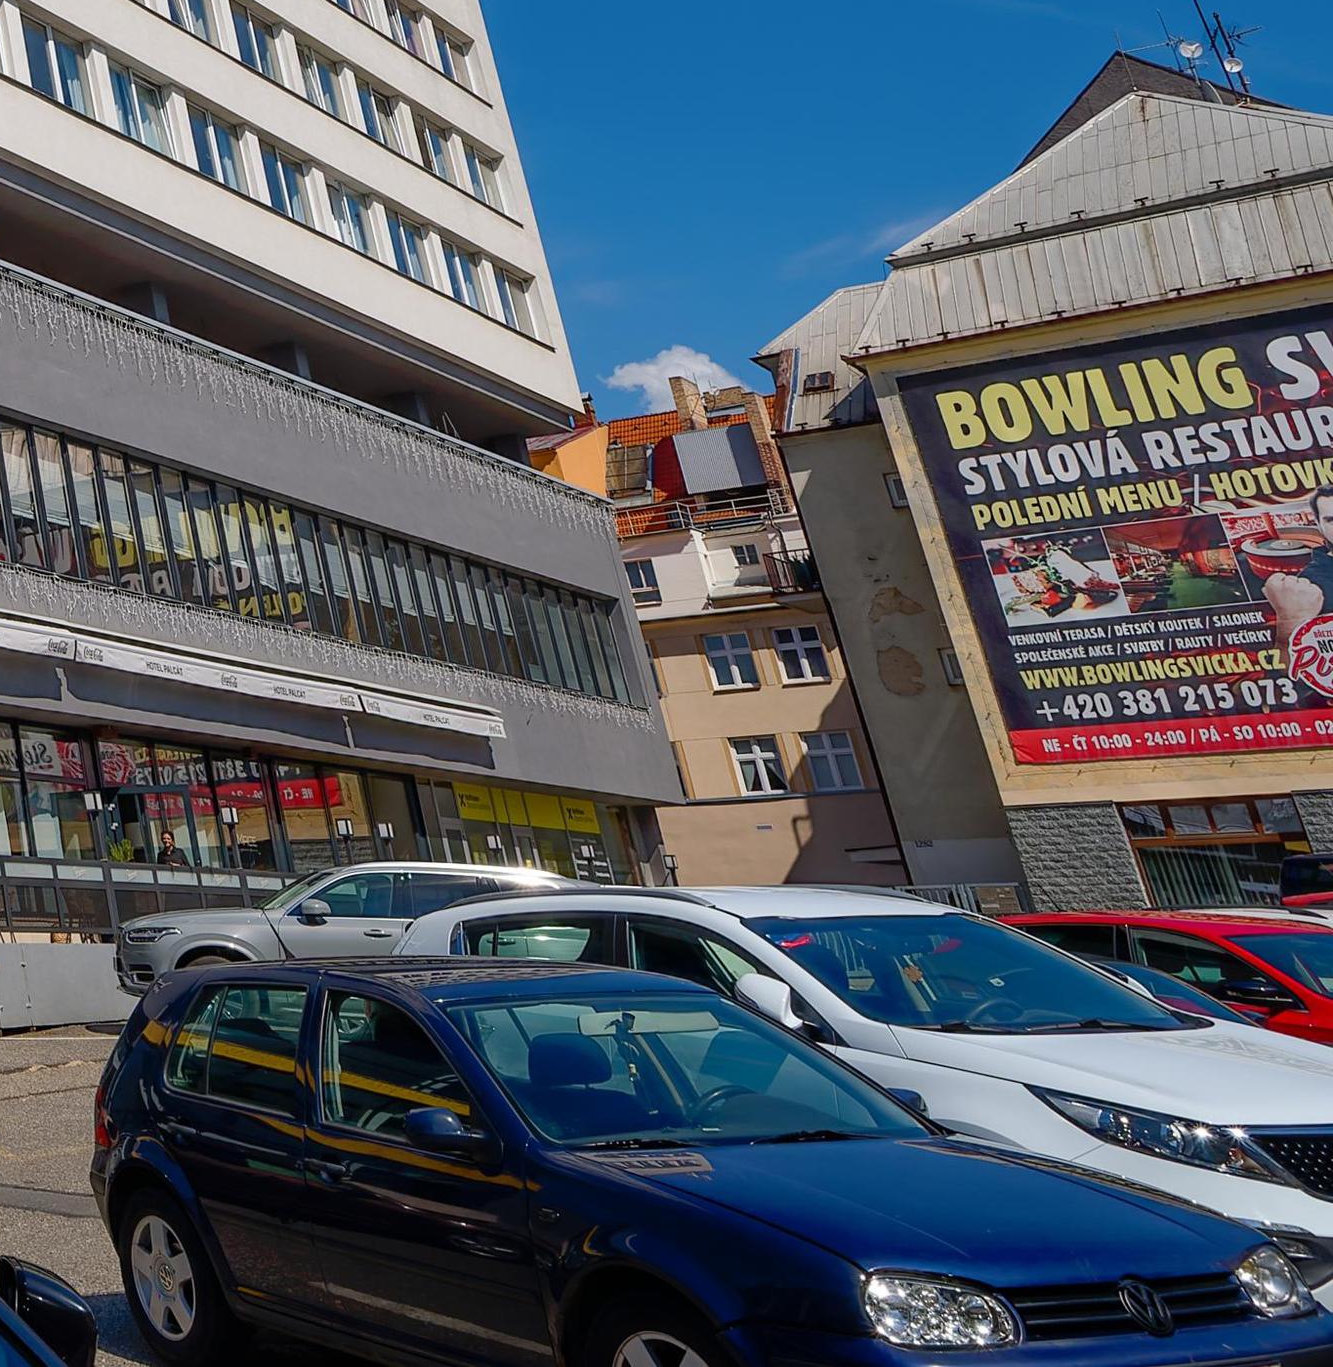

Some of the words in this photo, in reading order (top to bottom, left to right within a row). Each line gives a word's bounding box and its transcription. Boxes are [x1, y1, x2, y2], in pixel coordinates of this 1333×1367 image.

[935, 346, 1254, 450] BOWLING
[958, 429, 1139, 495] STYLOVÁ
[1141, 405, 1333, 470] RESTAUR
[971, 486, 1094, 531] POLEDNÍ
[1096, 479, 1183, 514] MENU
[1008, 629, 1062, 647] VENKOVNÍ
[1063, 626, 1106, 642] TERASA
[1114, 620, 1156, 637] DĚTSKÝ
[1157, 617, 1204, 633] KOUTEK
[1212, 611, 1266, 628] SALONEK
[1014, 645, 1087, 664] SPOLEČENSKÉ
[1088, 644, 1115, 658] AKCE
[1123, 639, 1165, 655] SVATBY
[1175, 635, 1214, 650] RAUTY
[1223, 629, 1273, 645] VEČÍRKY
[1019, 649, 1286, 690] WWW.BOWLINGSVICKA.CZ
[1036, 692, 1114, 722] +420
[1117, 687, 1172, 716] 381
[1178, 683, 1235, 712] 215
[1240, 678, 1298, 707] 073
[1042, 738, 1062, 753] NE
[1072, 734, 1088, 751] ČT
[1091, 734, 1132, 750] 10:00
[1145, 730, 1187, 747] 24:00
[1198, 725, 1222, 743] PÁ
[1233, 725, 1255, 741] SO
[1257, 721, 1302, 738] 10:00
